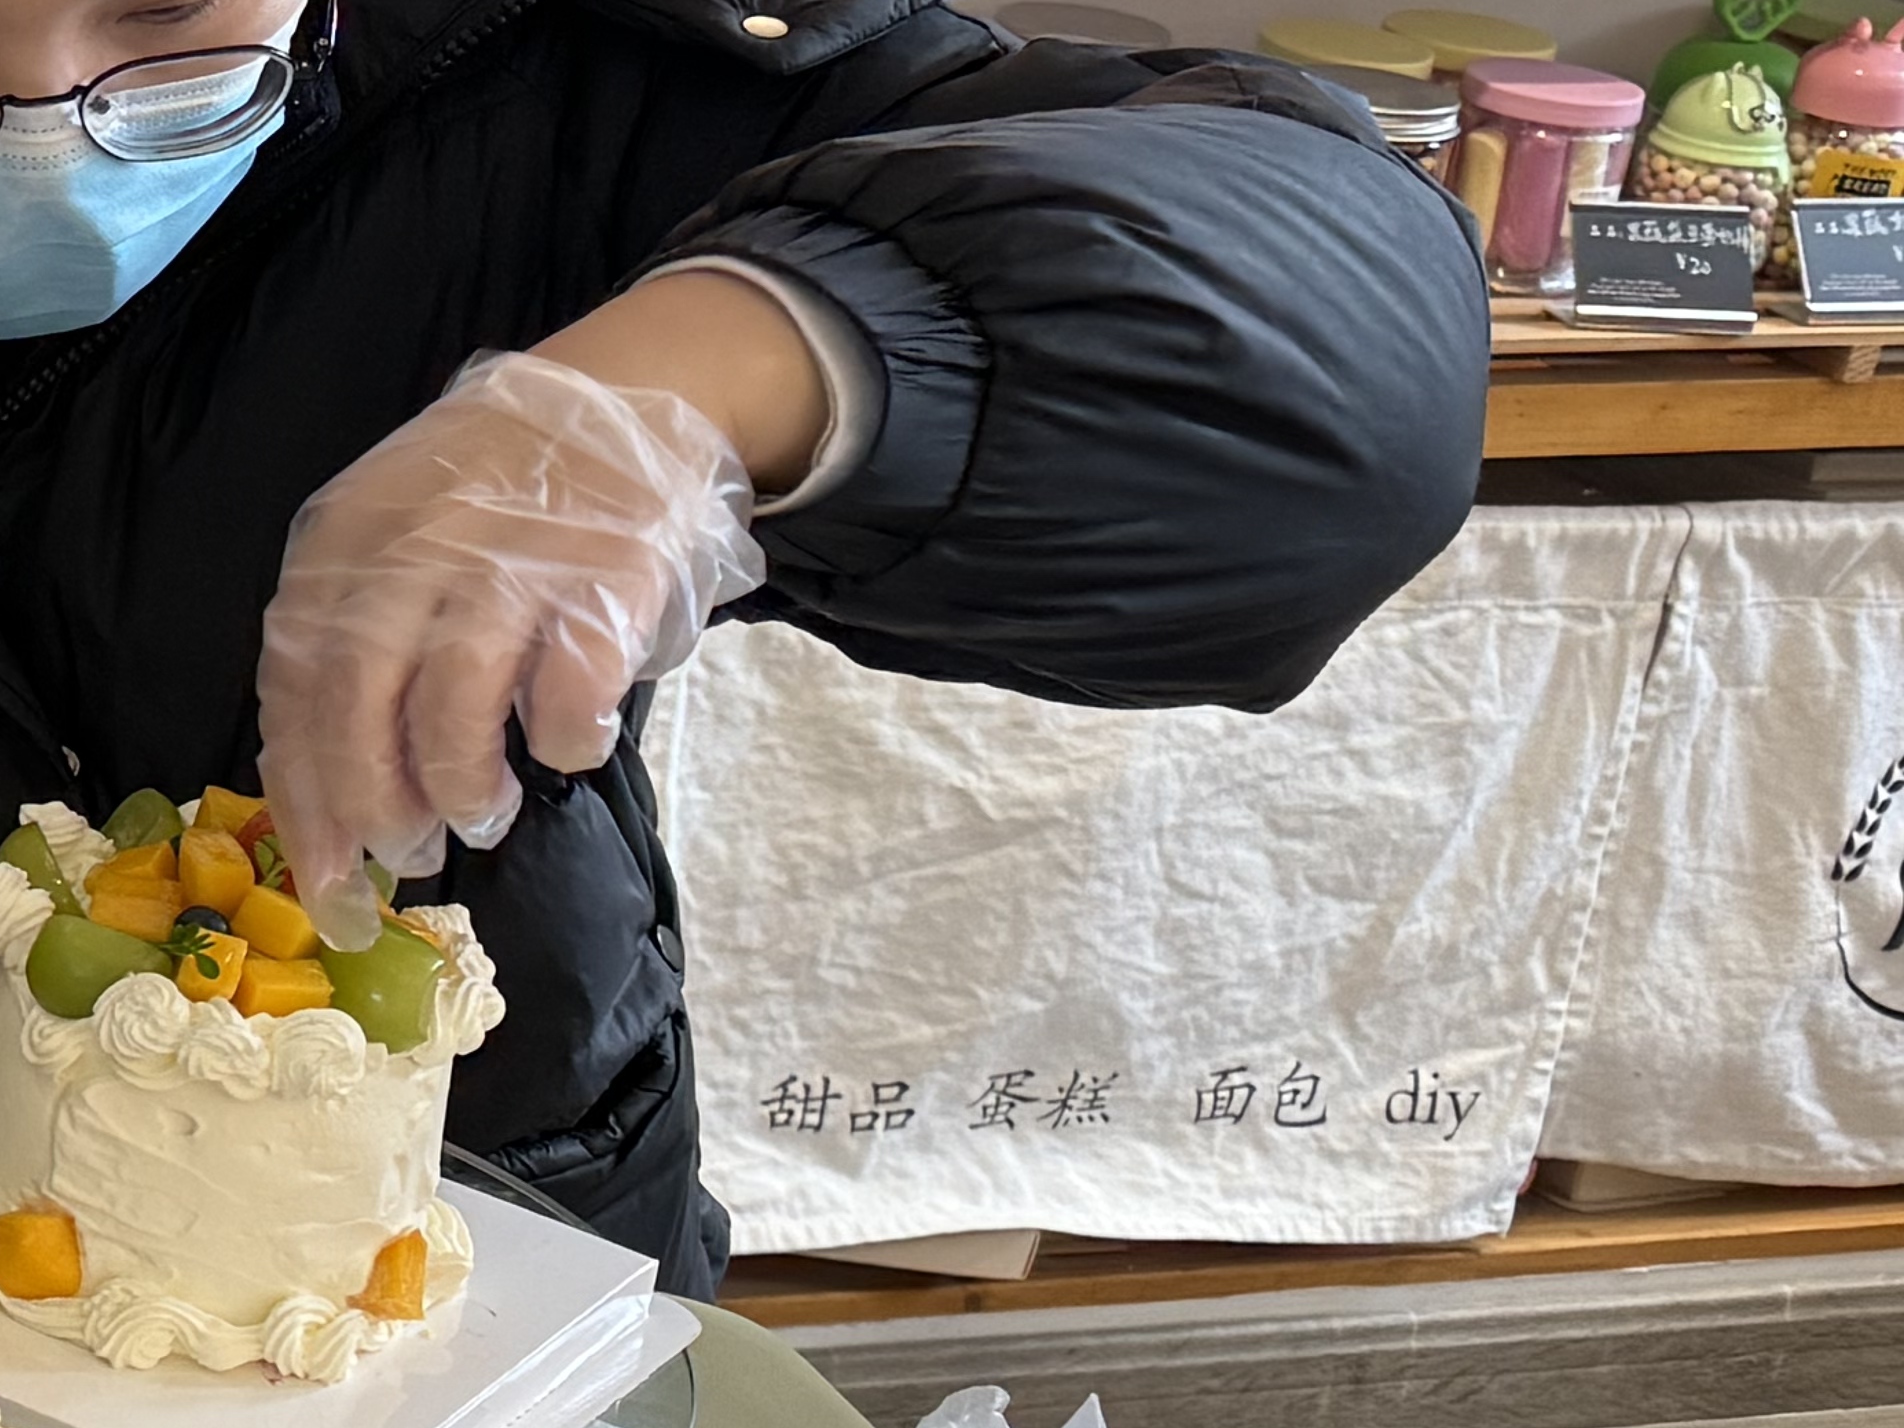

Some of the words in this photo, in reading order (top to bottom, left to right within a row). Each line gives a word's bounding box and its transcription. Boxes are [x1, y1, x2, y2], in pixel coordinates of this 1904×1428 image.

[760, 1074, 916, 1135] 甜品
[967, 1067, 1121, 1132] 蛋糕
[1191, 1060, 1328, 1129] 面包
[1384, 1069, 1481, 1141] diy
